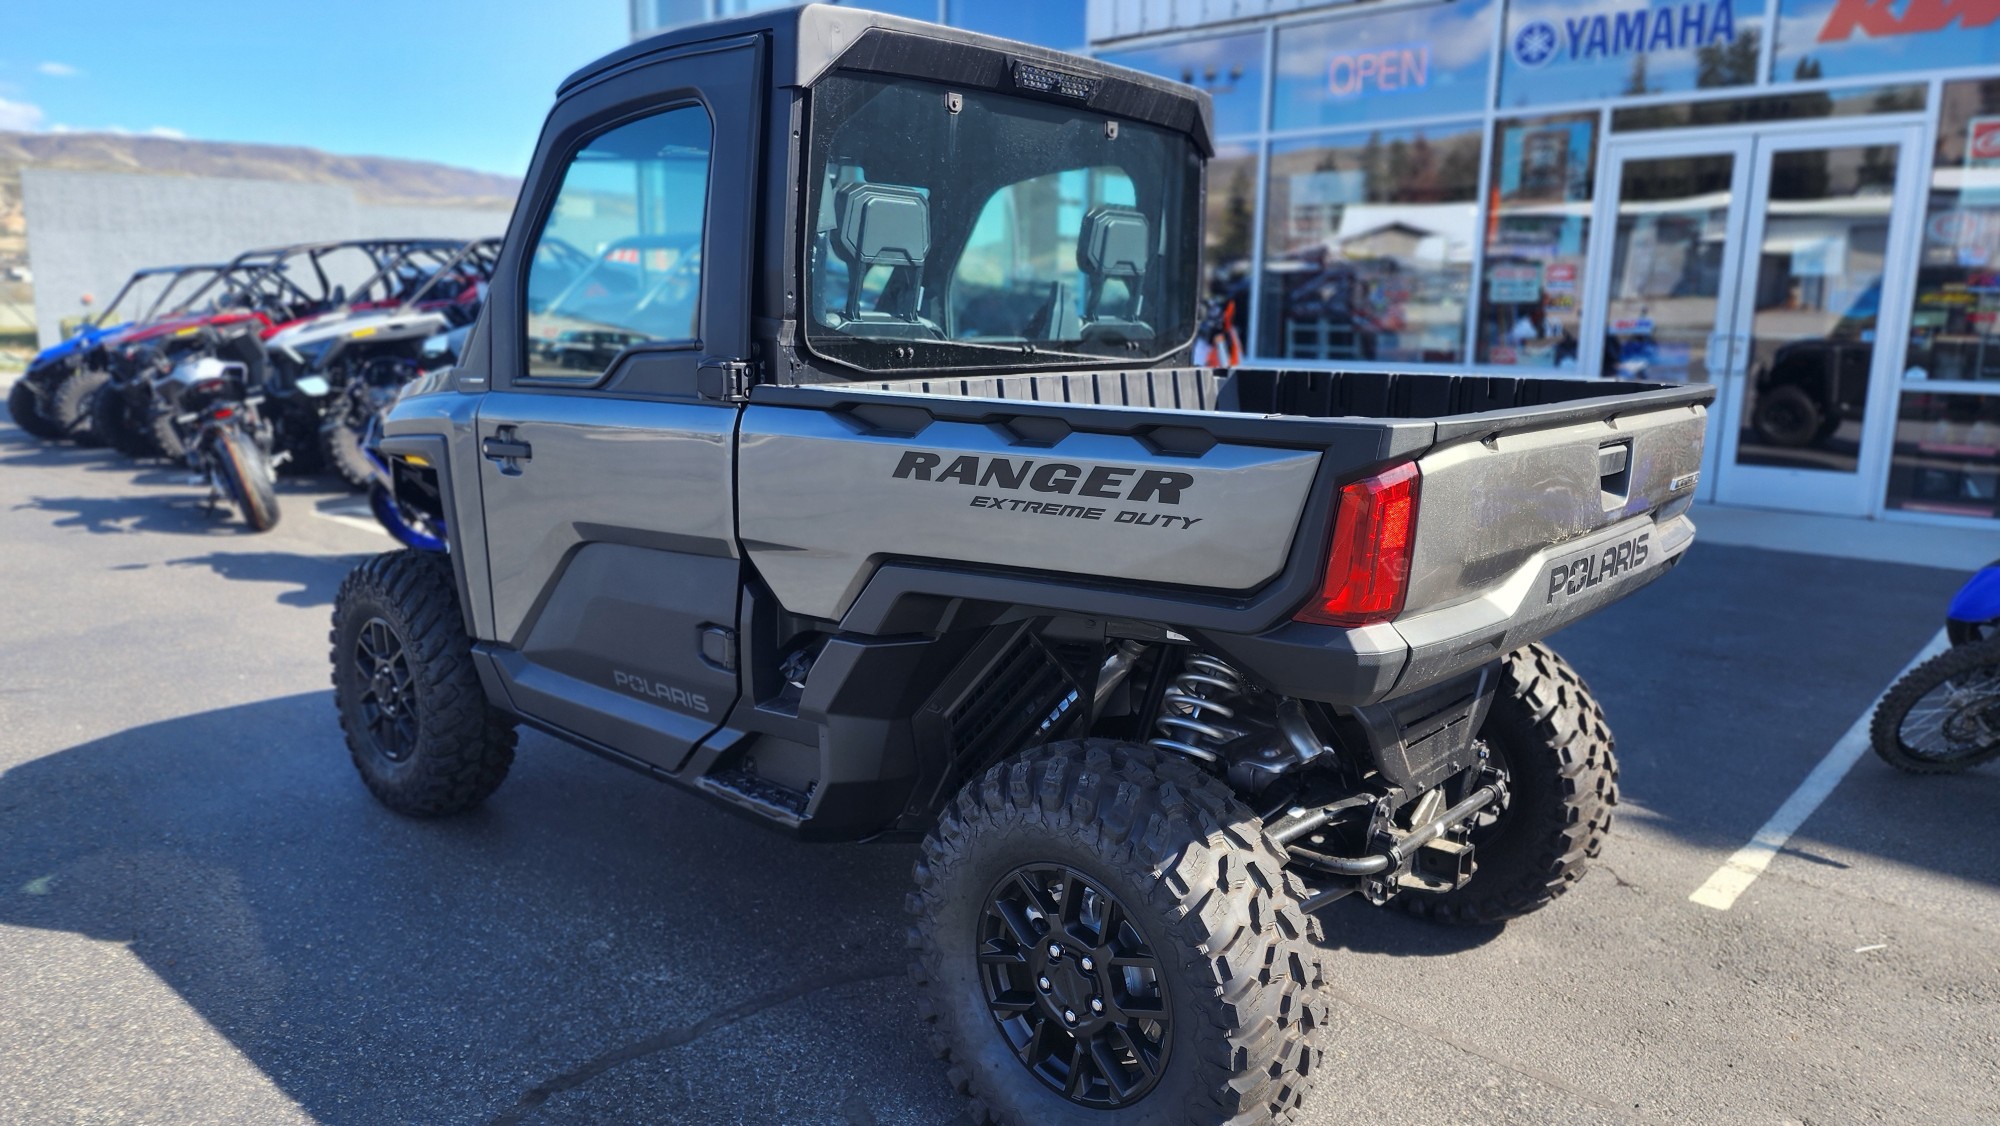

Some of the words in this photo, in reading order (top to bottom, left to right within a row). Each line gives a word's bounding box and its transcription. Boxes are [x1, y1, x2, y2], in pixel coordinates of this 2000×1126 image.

[1565, 0, 1735, 61] YAMAHA
[1328, 46, 1430, 96] OPEN
[891, 450, 1195, 505] RANGER
[970, 495, 1107, 521] EXTREME
[1113, 510, 1204, 531] DUTY
[1547, 532, 1650, 605] POLARIS
[612, 669, 710, 714] POLARIS
